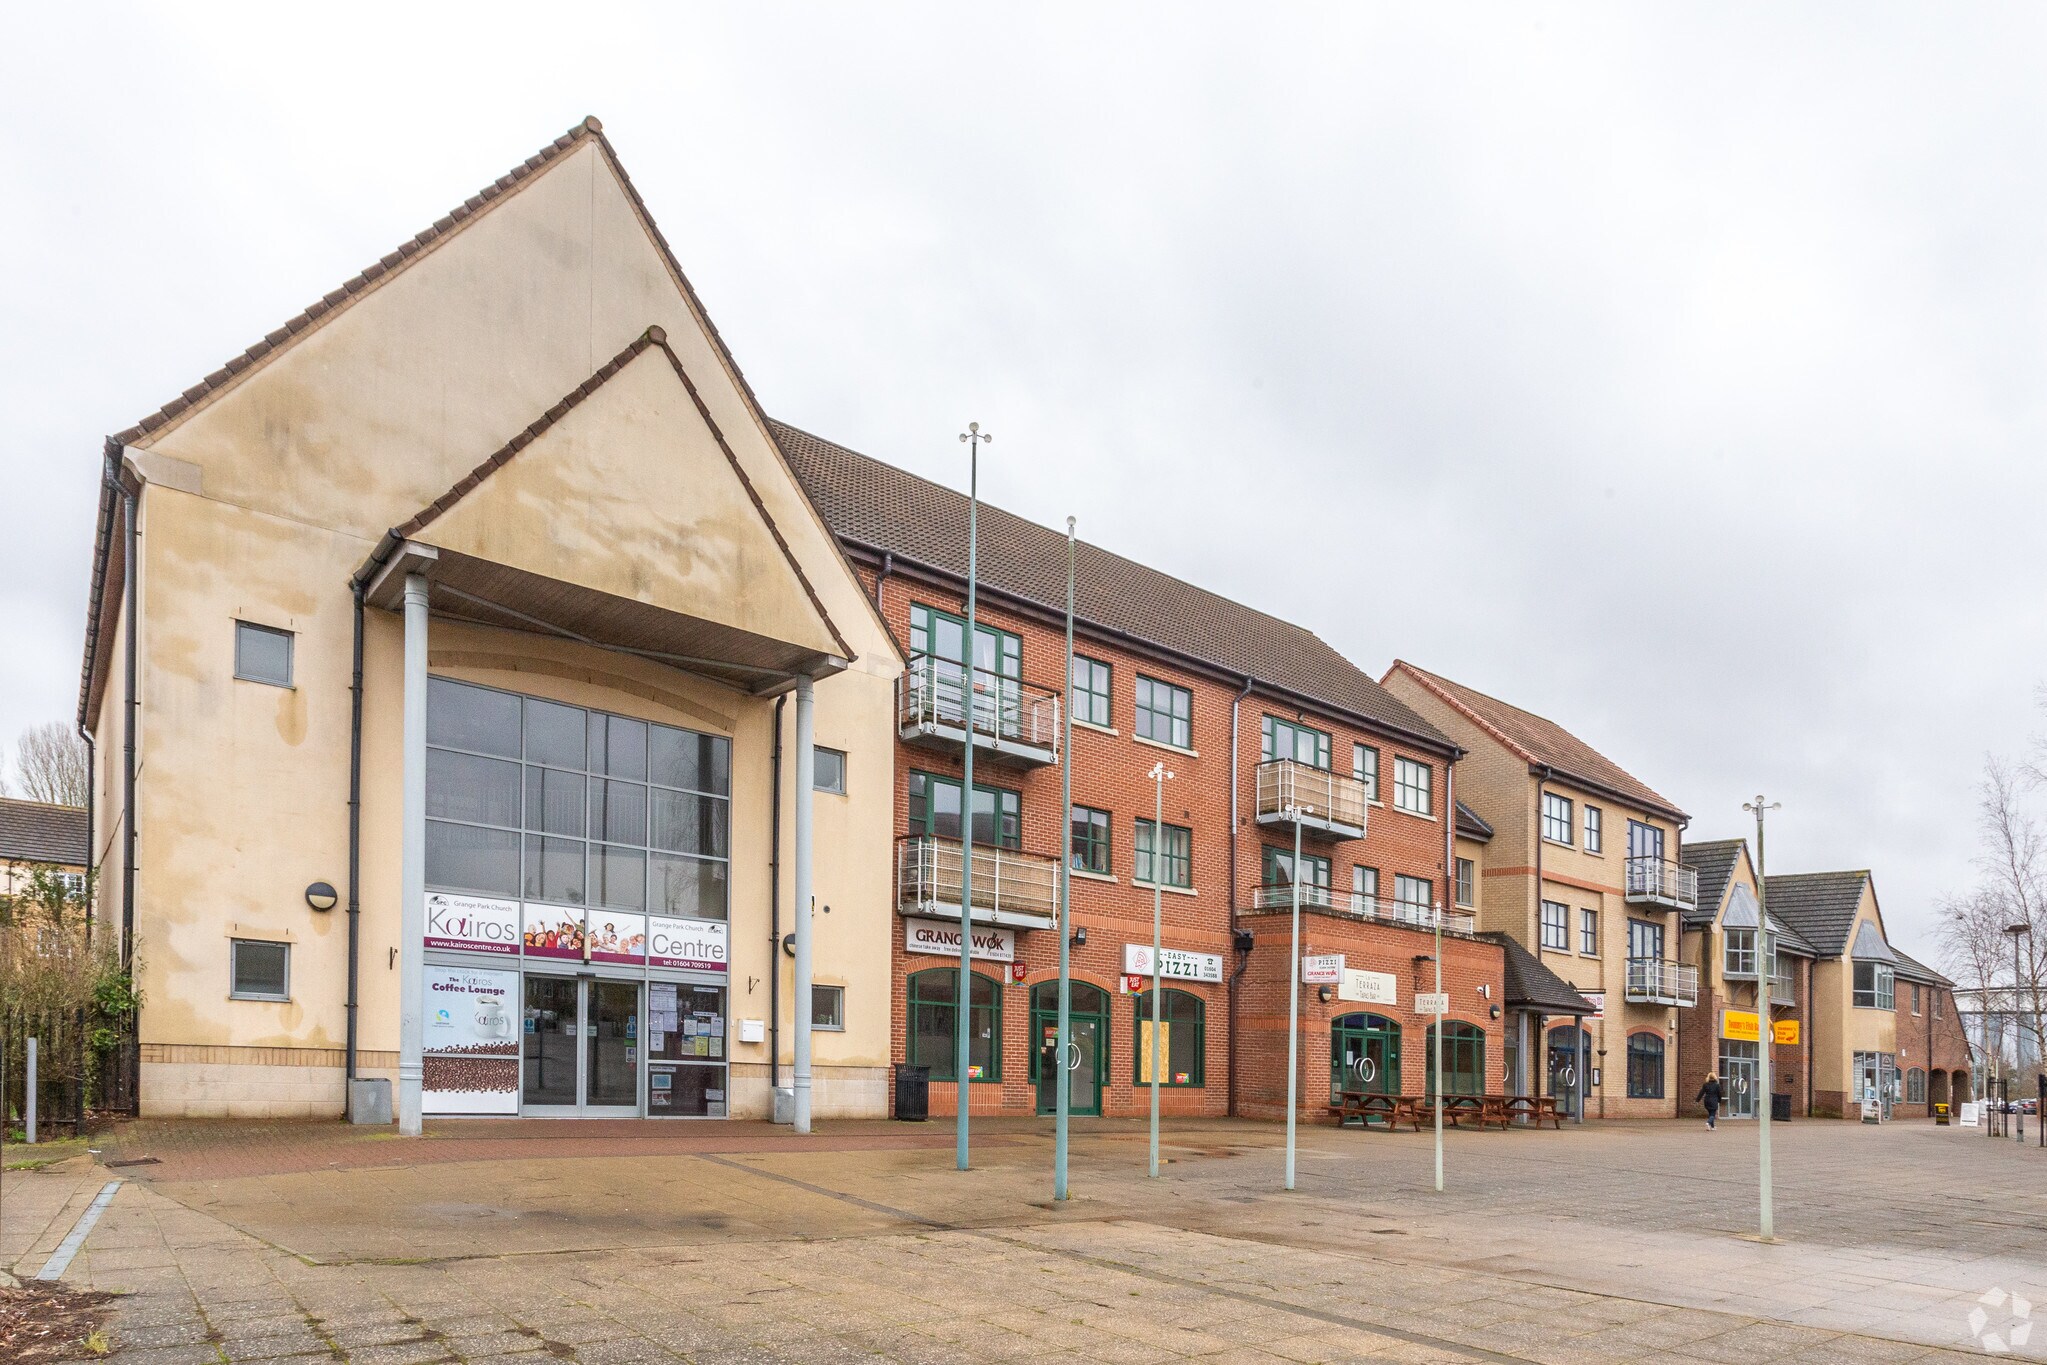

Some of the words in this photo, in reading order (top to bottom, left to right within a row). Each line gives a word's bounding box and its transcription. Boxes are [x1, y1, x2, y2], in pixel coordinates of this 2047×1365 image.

[454, 900, 476, 909] Grange
[491, 904, 513, 912] Church
[428, 907, 515, 941] Kairos
[652, 921, 672, 930] Grange
[916, 928, 962, 945] GRANG
[972, 933, 1004, 951] WOK
[430, 940, 511, 953] www.kairoscentre.co.uk
[652, 934, 724, 960] Centre
[673, 960, 690, 968] 01604
[1013, 965, 1024, 973] JUST
[462, 974, 493, 986] Kairos
[432, 983, 466, 992] Coffee
[468, 985, 506, 996] Lounge
